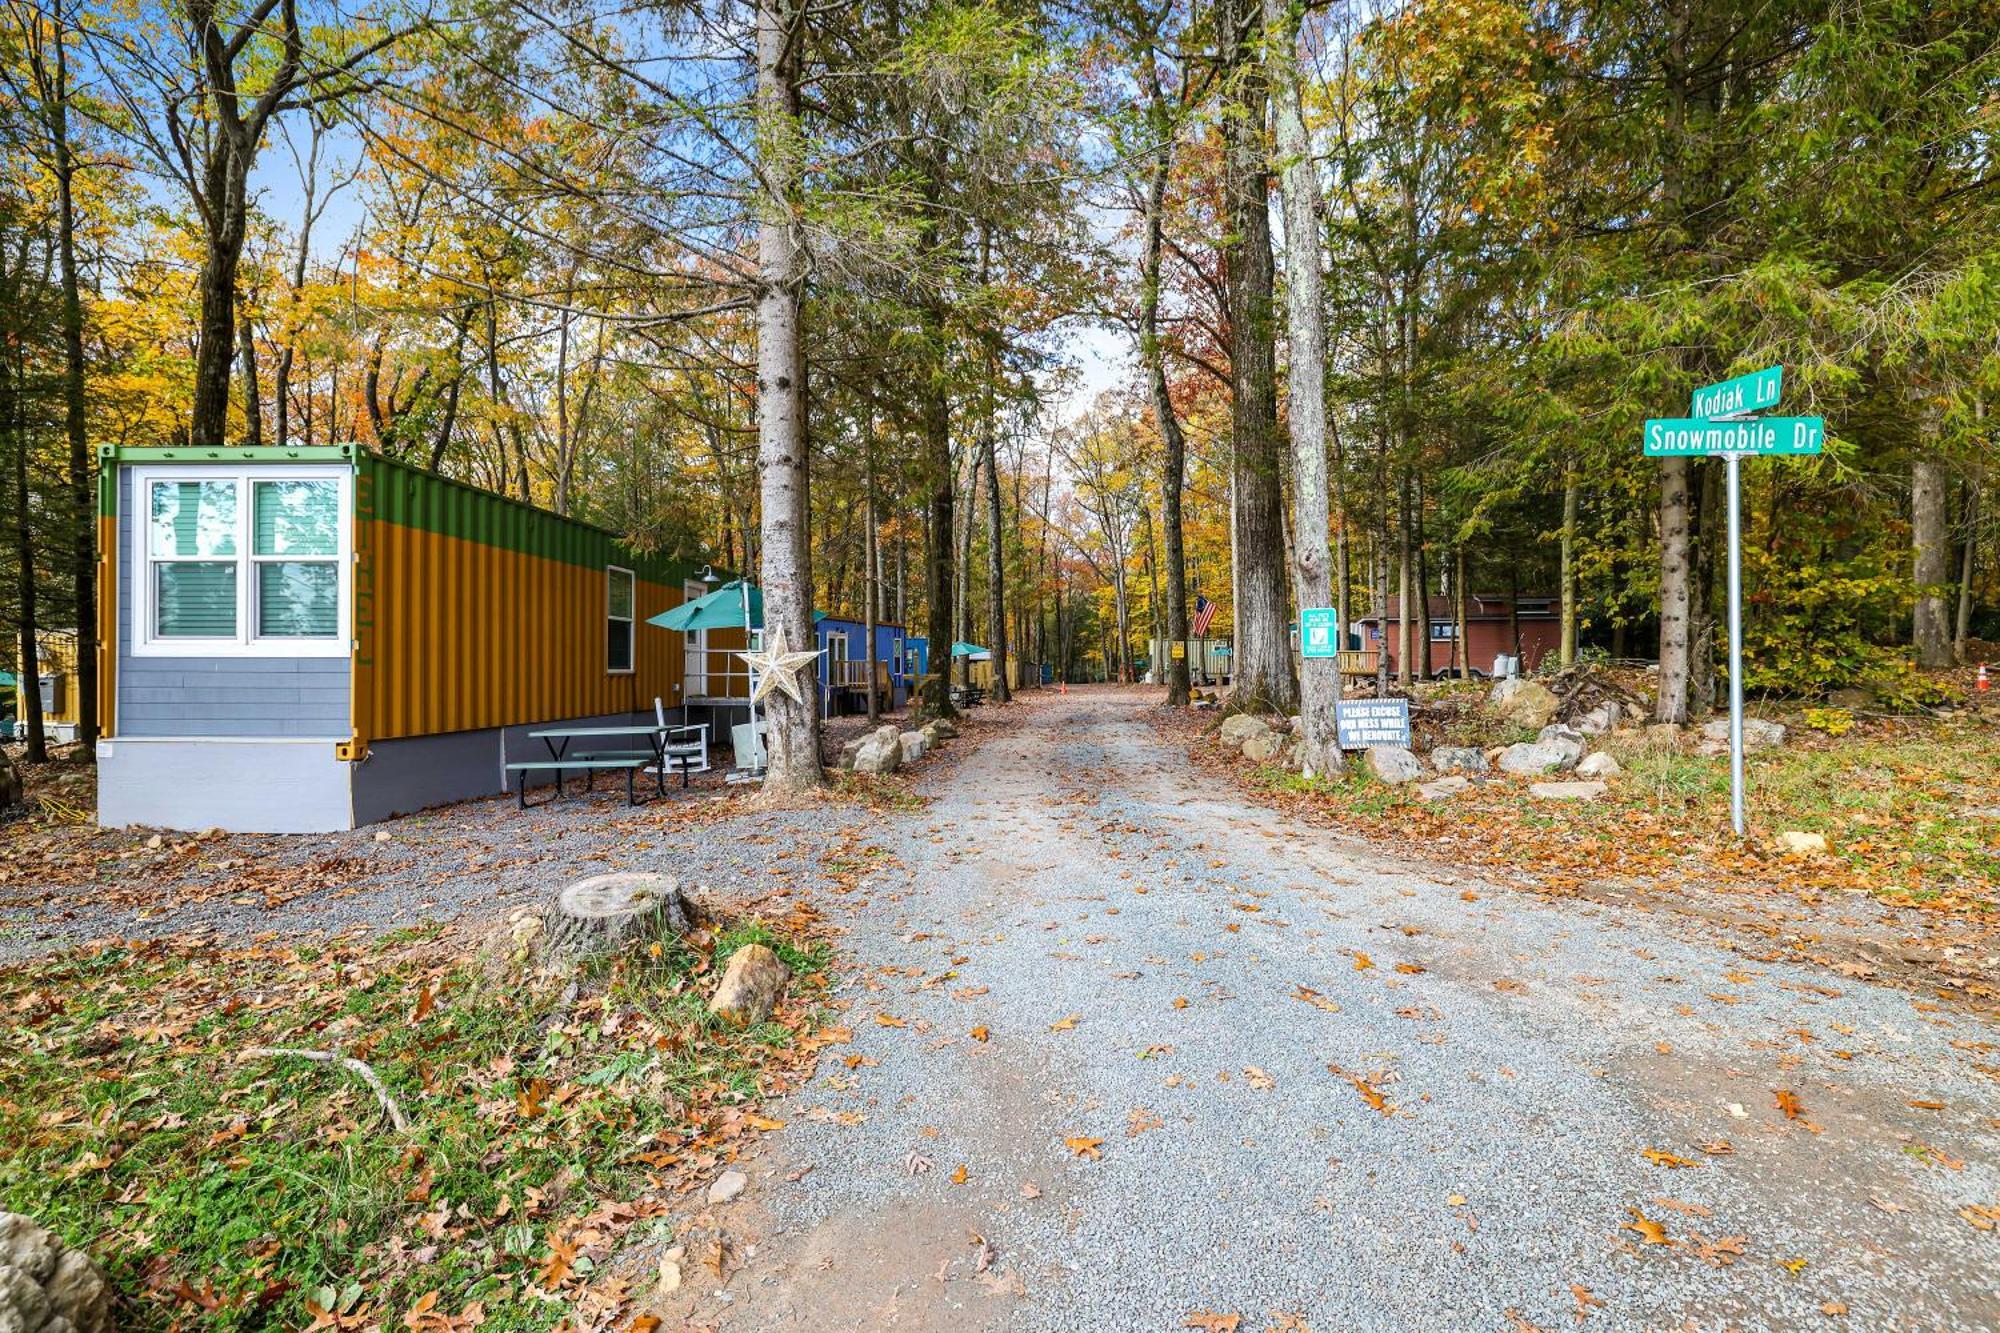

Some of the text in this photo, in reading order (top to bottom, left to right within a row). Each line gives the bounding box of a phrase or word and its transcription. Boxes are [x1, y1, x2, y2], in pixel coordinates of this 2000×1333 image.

[1695, 376, 1775, 418] Kodiak Ln
[1650, 422, 1817, 450] Snowmobile Dr
[1343, 705, 1401, 718] PLEASE EXCUSE
